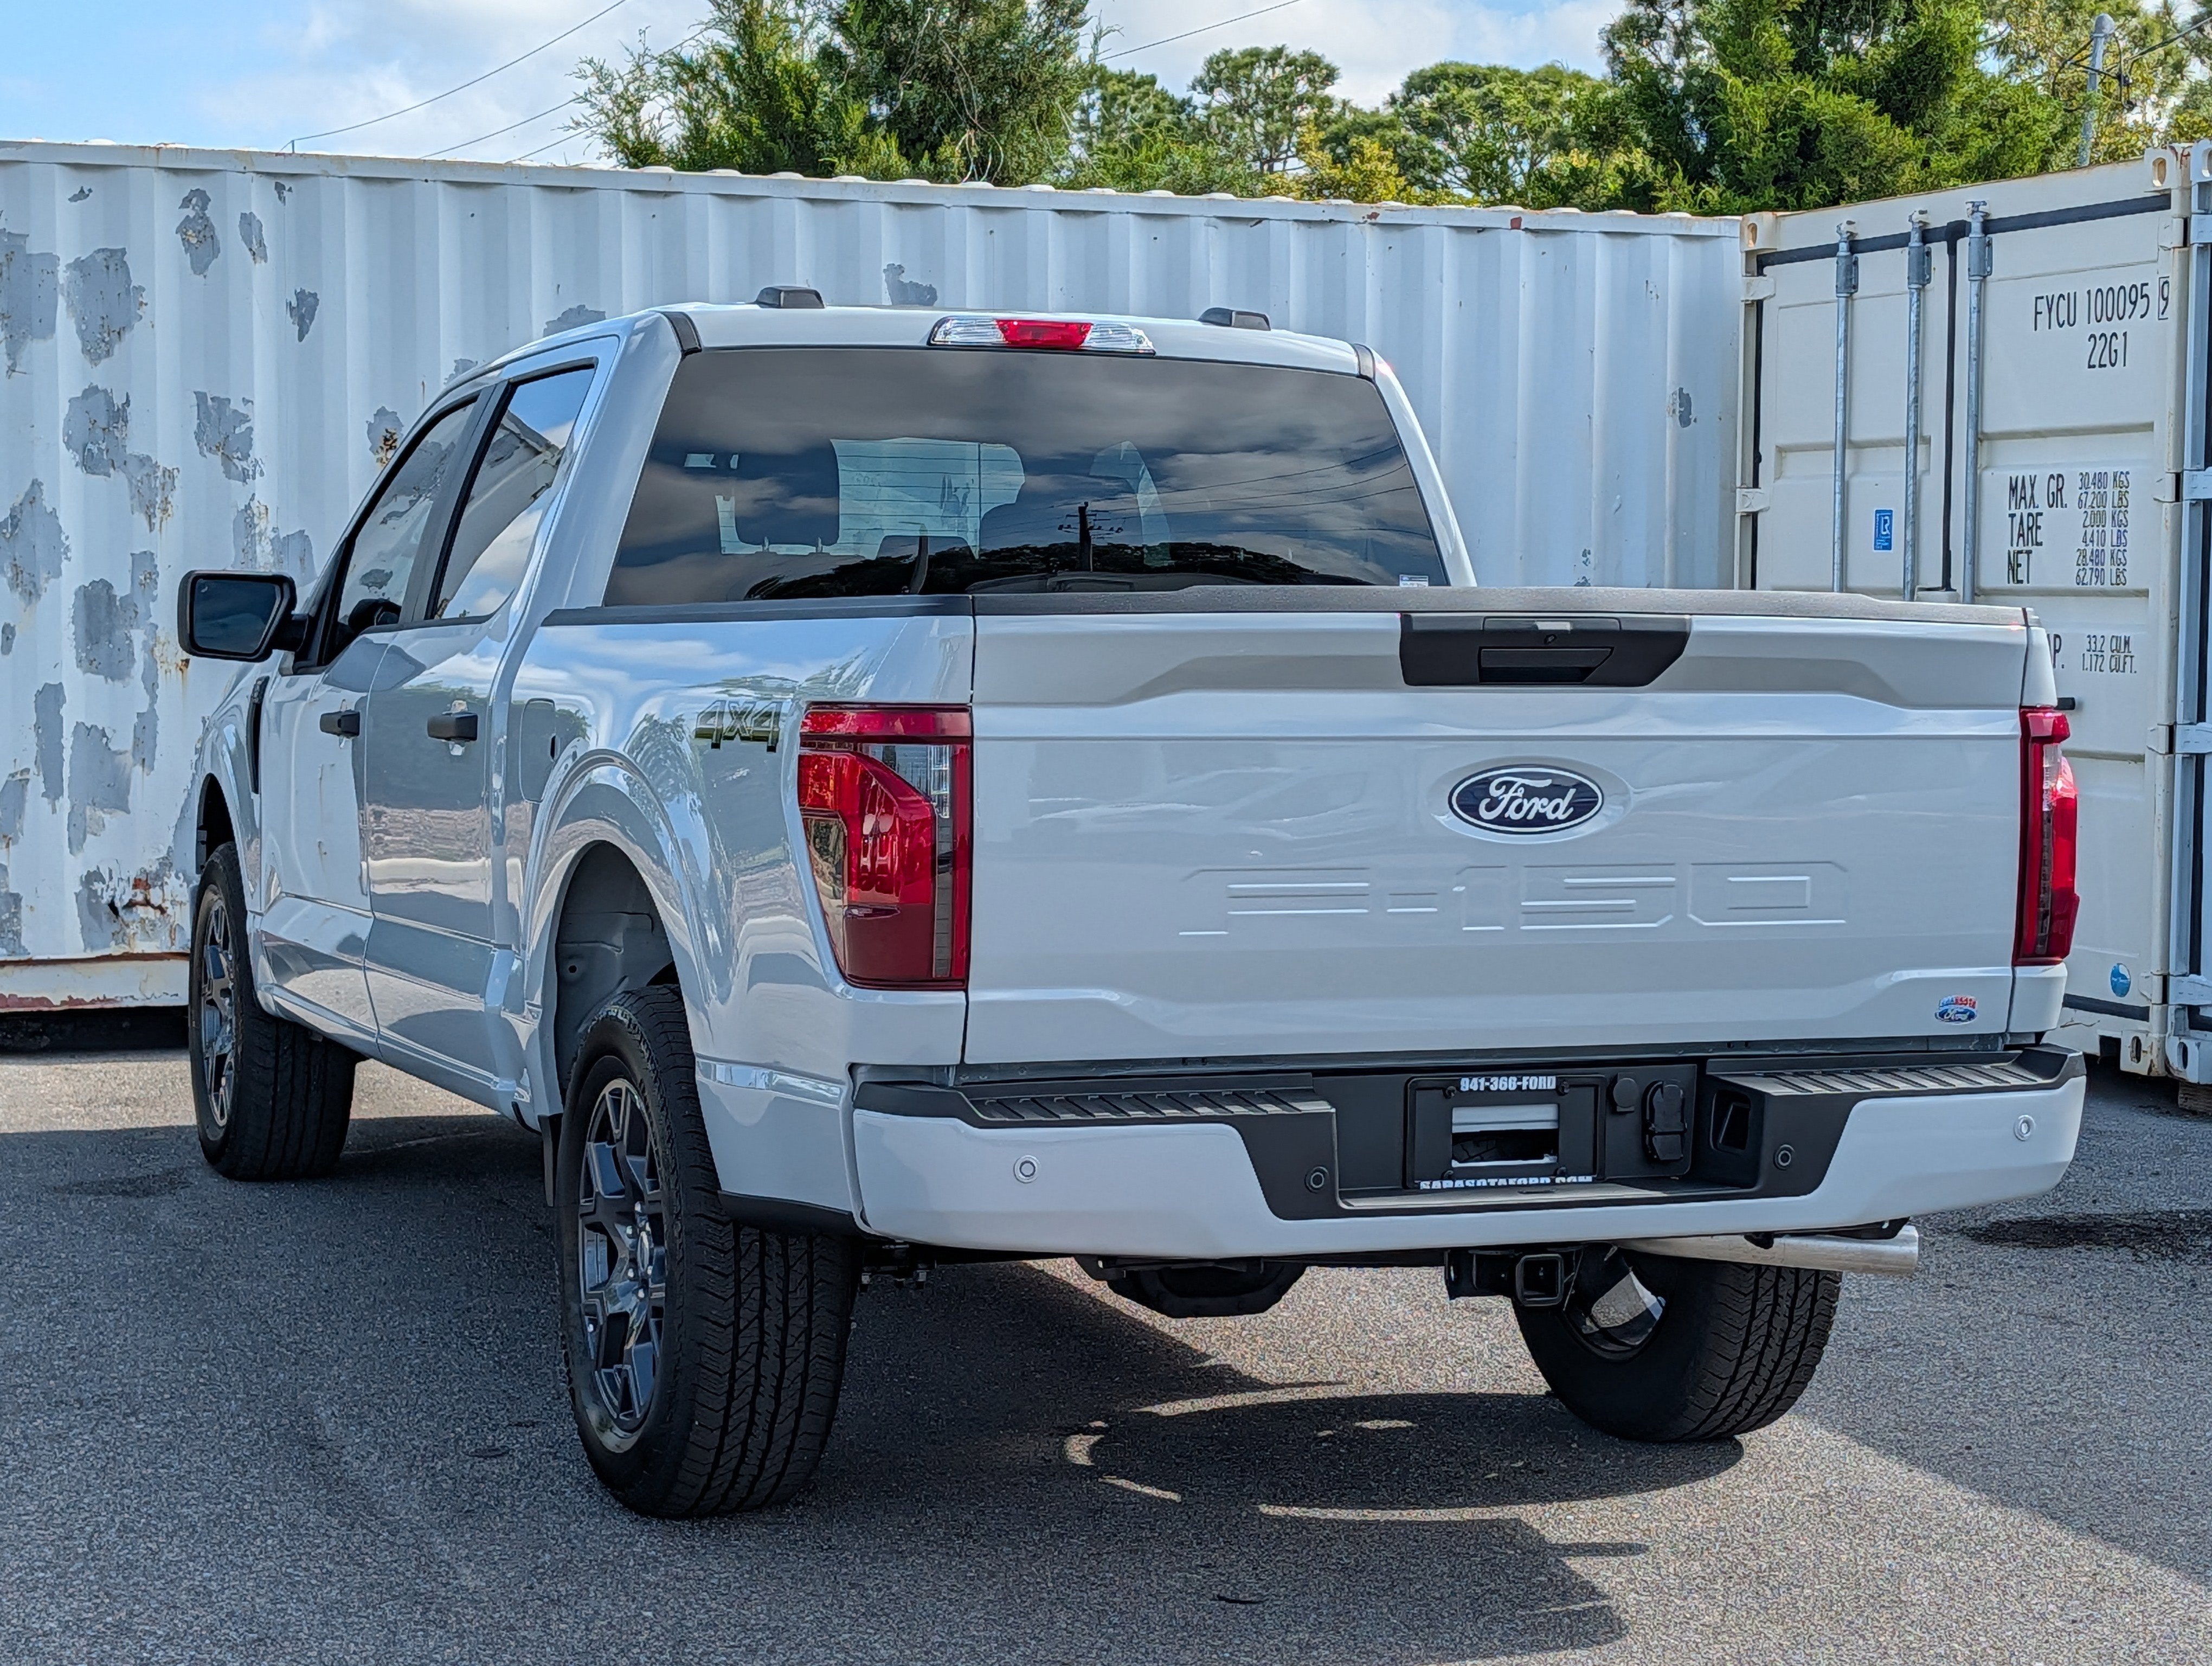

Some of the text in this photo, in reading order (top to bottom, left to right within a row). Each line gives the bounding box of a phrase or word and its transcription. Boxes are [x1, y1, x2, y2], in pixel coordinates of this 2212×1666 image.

[2034, 278, 2169, 331] FYCU 100095 9
[2087, 331, 2127, 369] 22G1
[2008, 475, 2039, 511] MAX.
[2047, 473, 2068, 508] GR.
[2112, 471, 2130, 489] KGS
[2112, 490, 2129, 508] LBS
[2008, 512, 2043, 547] TARE
[2111, 510, 2129, 528] KGS
[2111, 529, 2128, 547] LBS
[2007, 549, 2033, 584] NET
[2110, 548, 2127, 566] KGS
[2110, 568, 2127, 586] LBS
[1478, 777, 1576, 819] Ford
[1179, 861, 1847, 935] F-150
